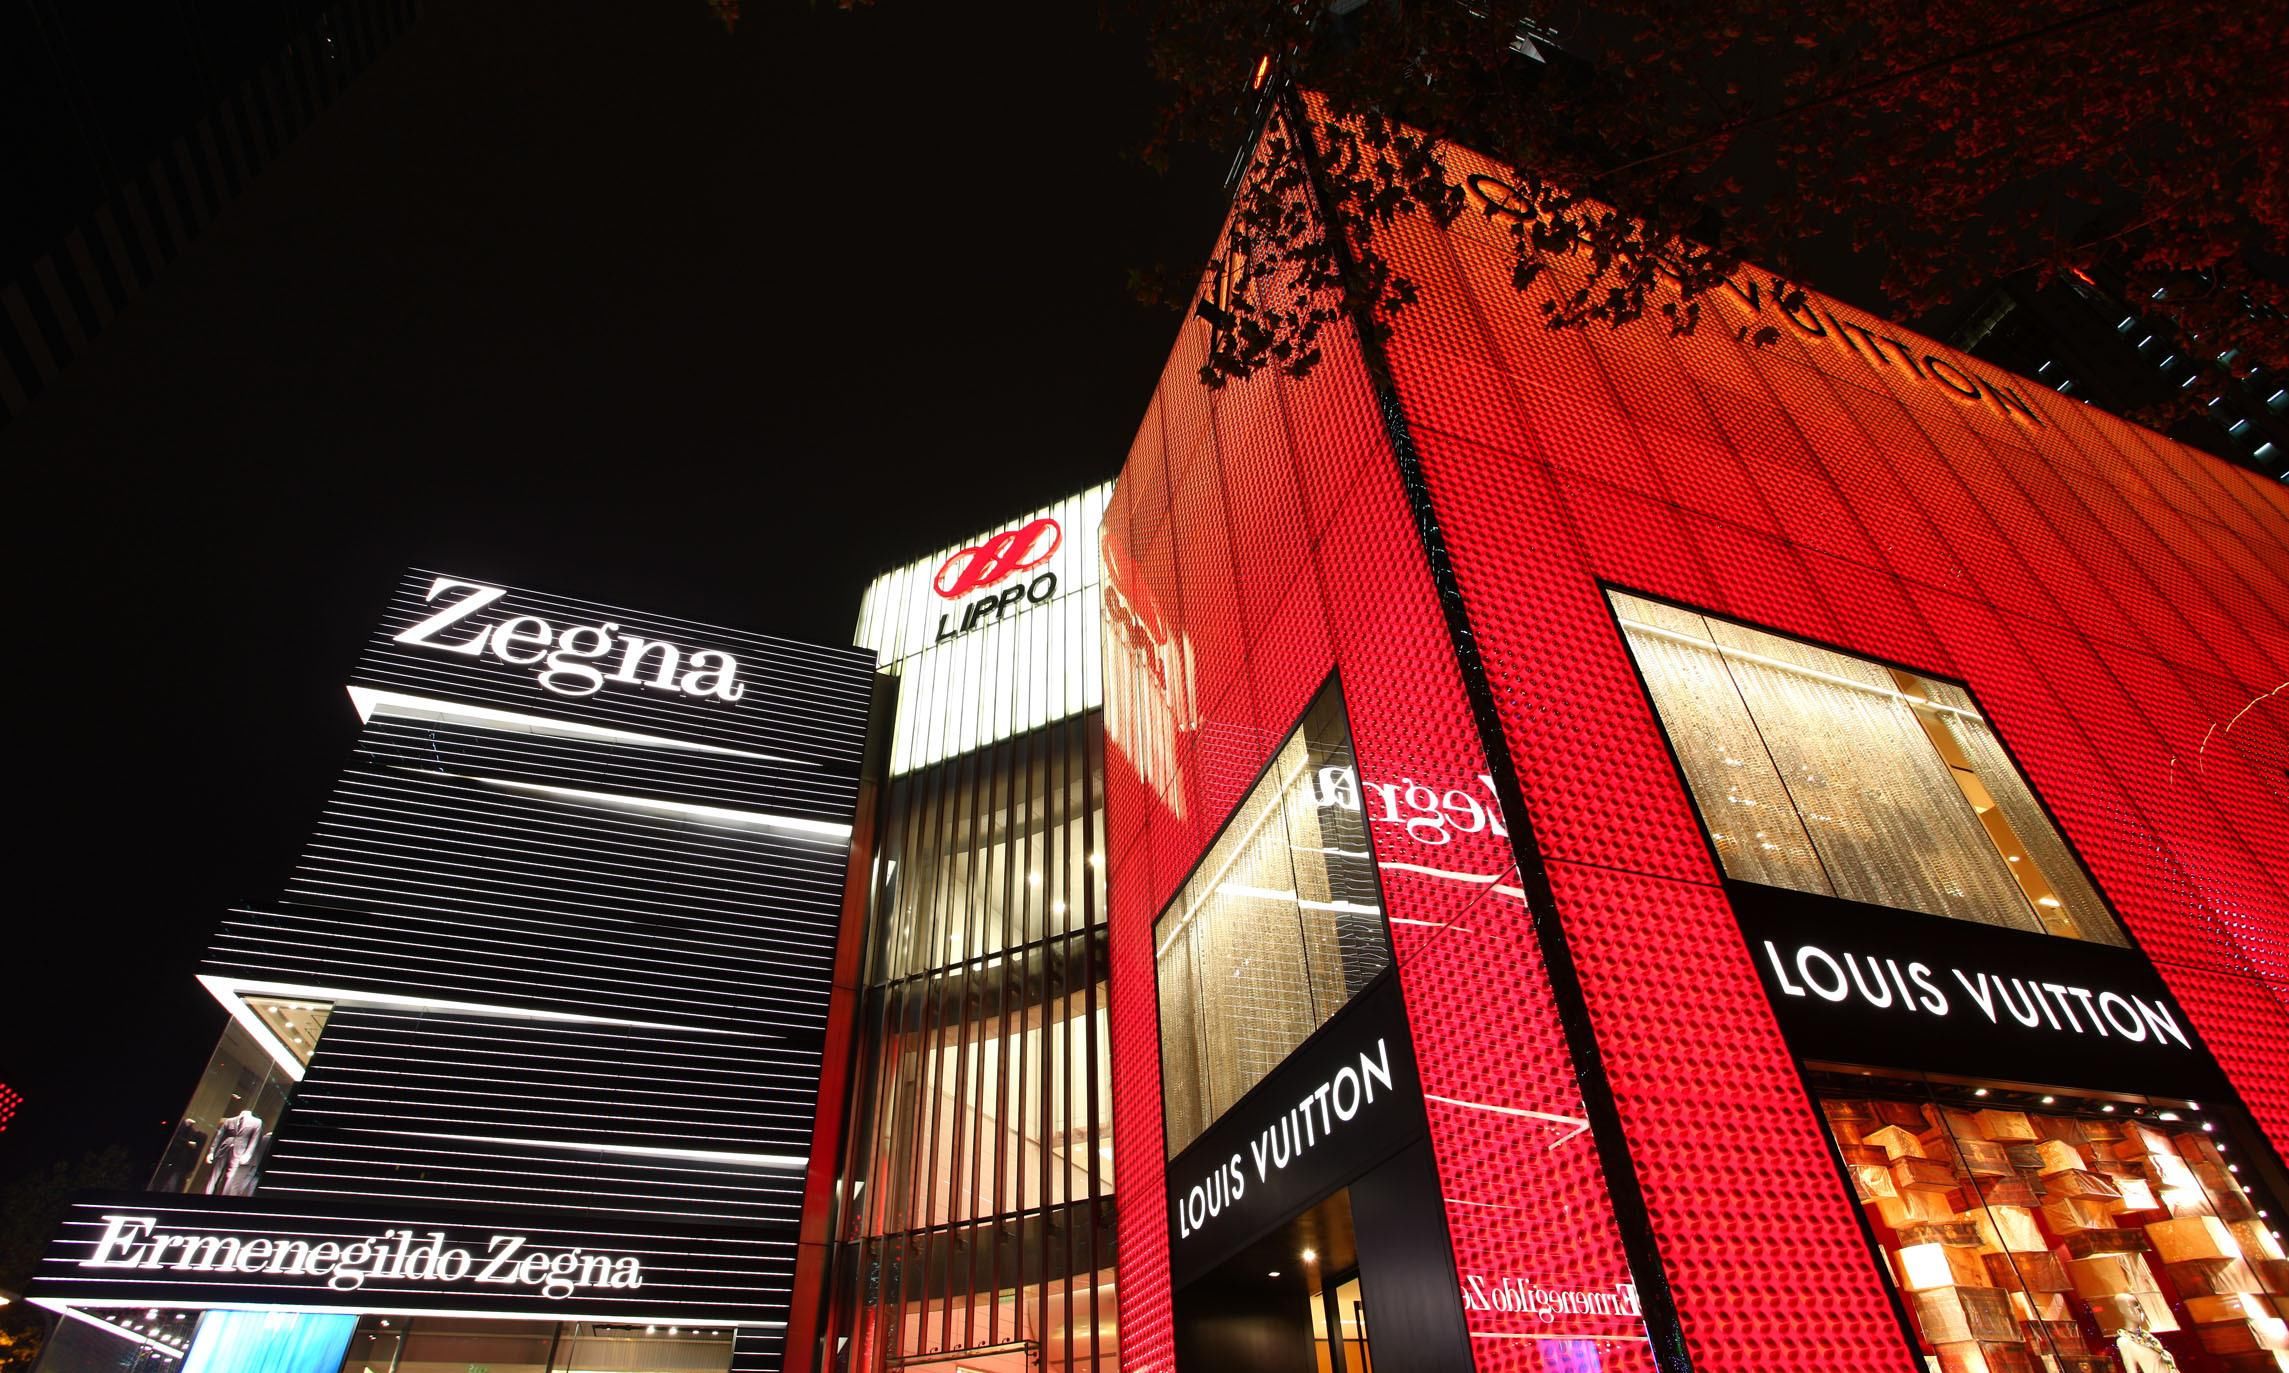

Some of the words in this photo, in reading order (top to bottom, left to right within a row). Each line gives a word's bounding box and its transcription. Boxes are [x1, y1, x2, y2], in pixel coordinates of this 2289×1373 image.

[393, 577, 743, 701] Zegna
[935, 571, 1057, 643] LIPPO
[1763, 940, 1949, 1016] LOUIS
[1952, 968, 2192, 1050] VUITTON
[1179, 1153, 1245, 1239] LOUIS
[1251, 1038, 1393, 1183] VUITTON
[80, 1215, 471, 1291] Ermenegildo
[475, 1235, 642, 1299] Zegna
